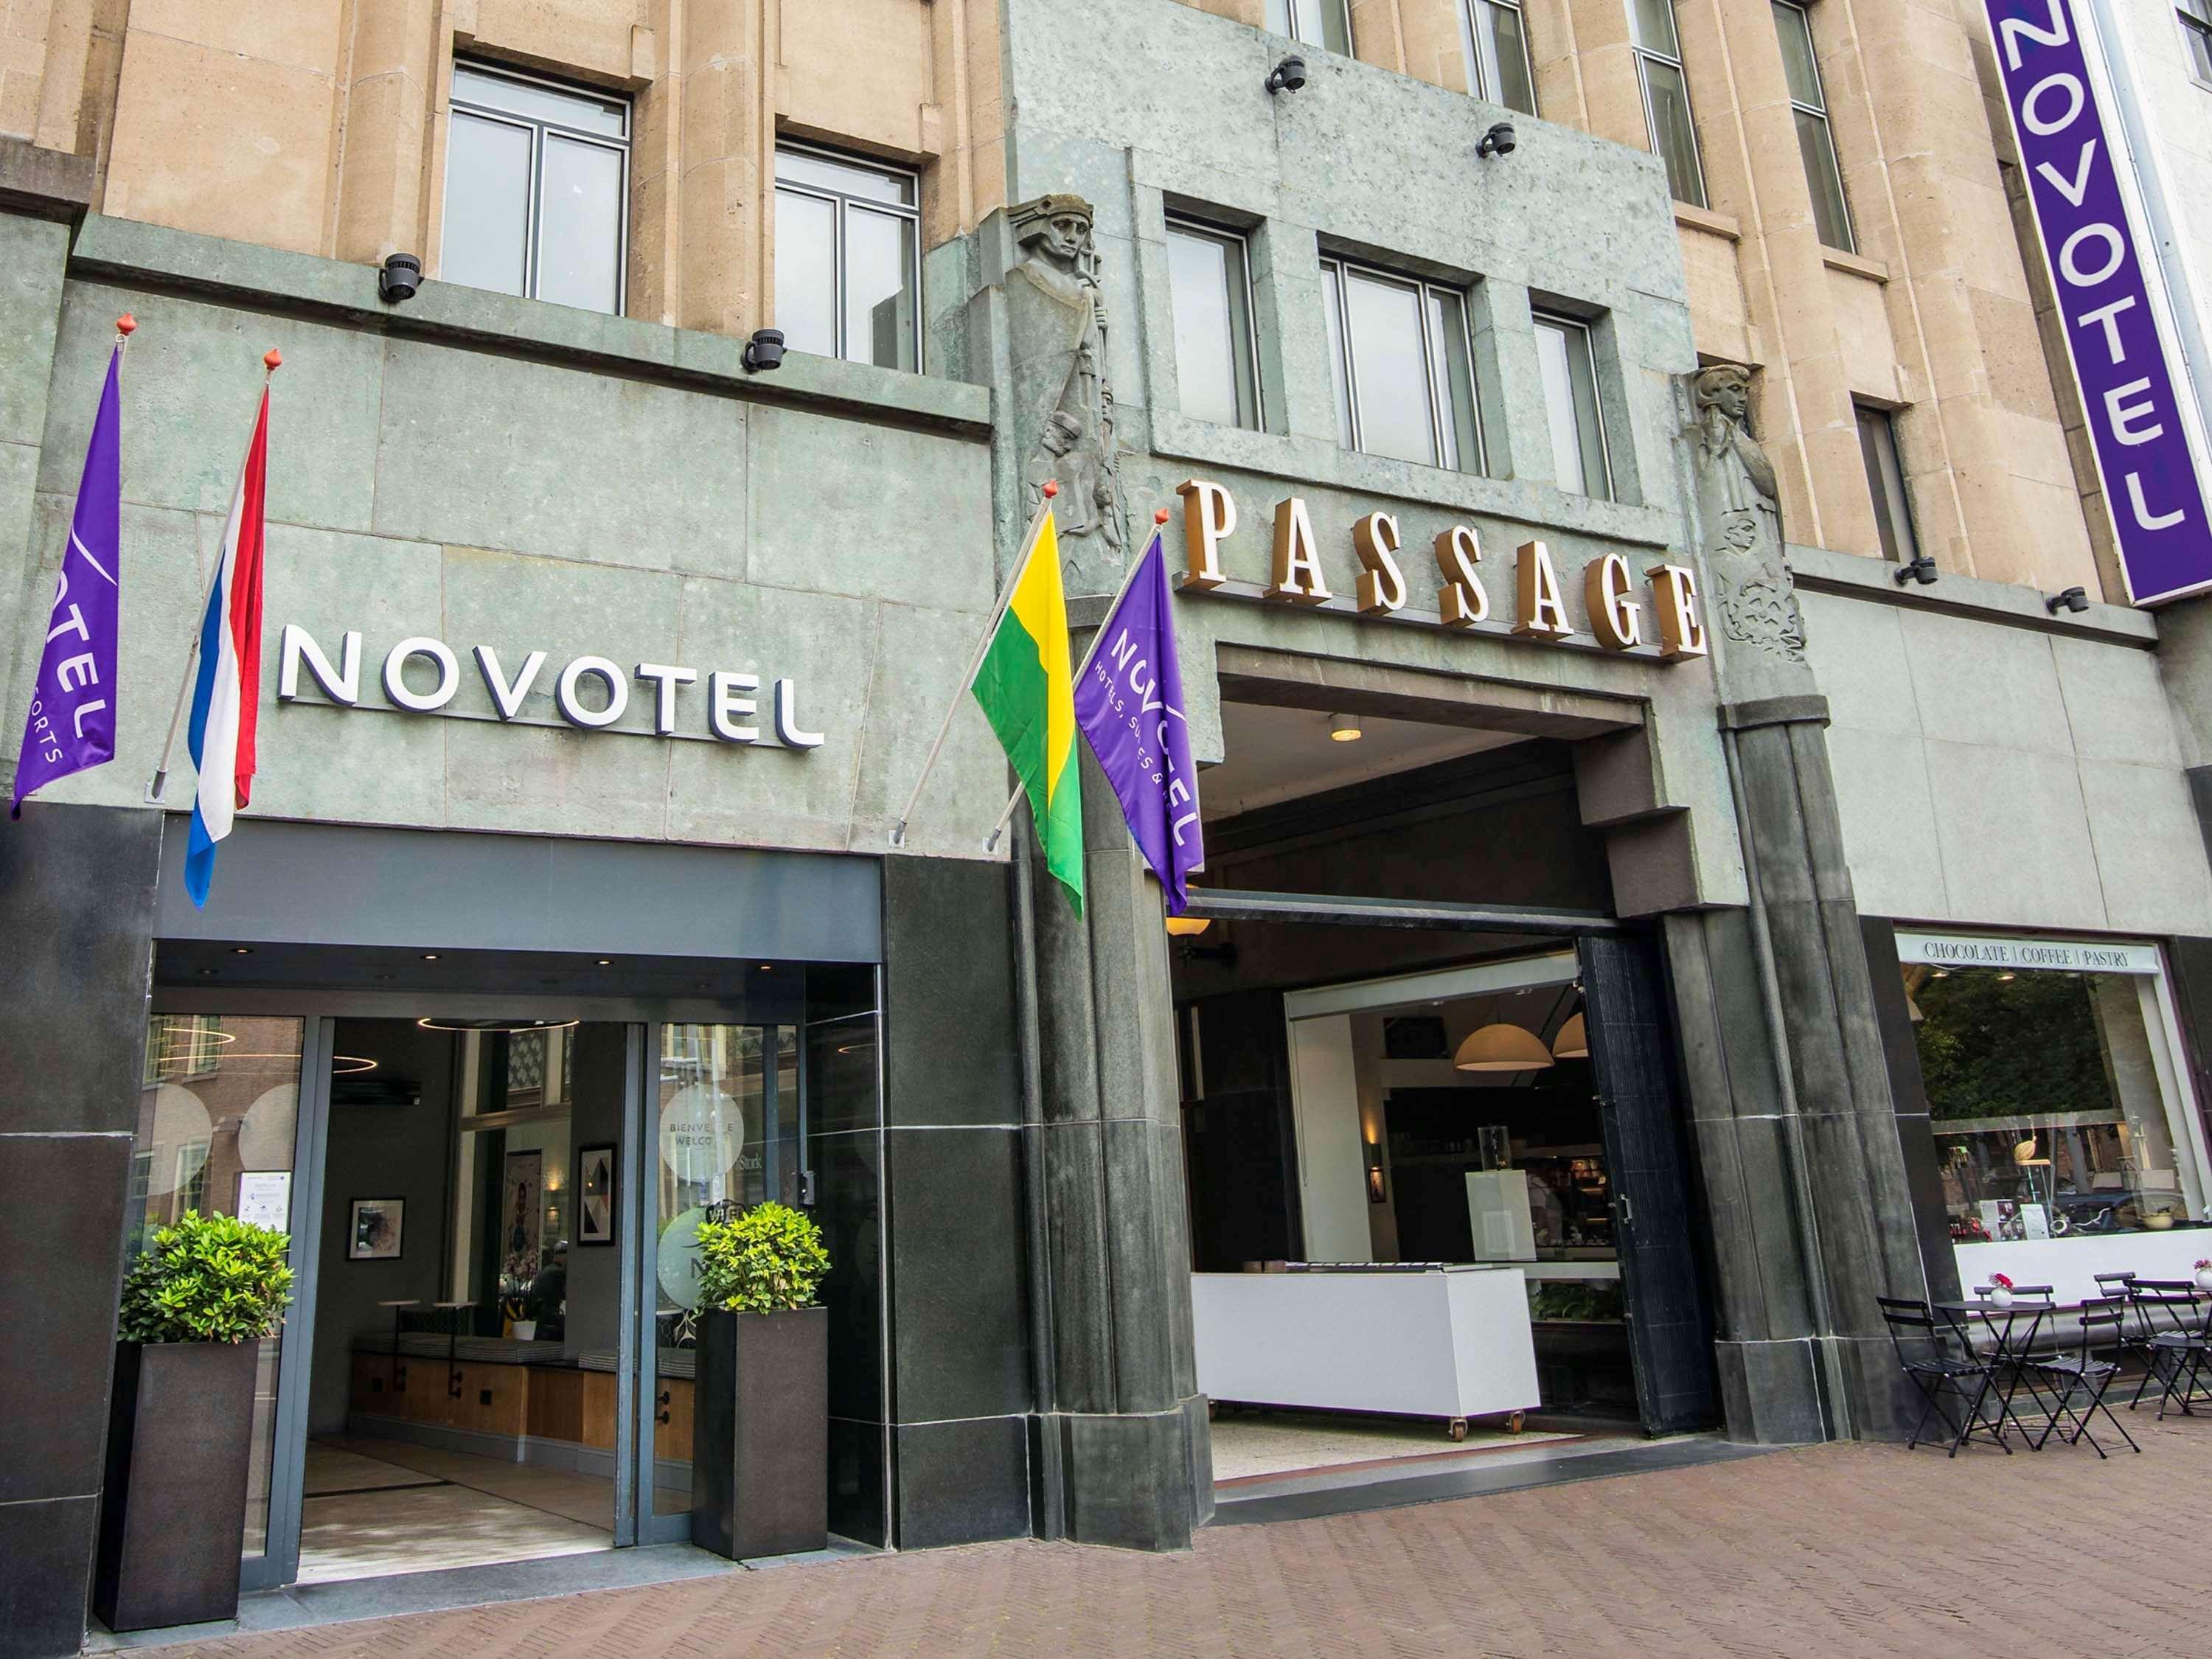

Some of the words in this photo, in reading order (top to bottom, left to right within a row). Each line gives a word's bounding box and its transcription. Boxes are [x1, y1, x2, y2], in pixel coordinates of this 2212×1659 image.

[1998, 0, 2186, 532] NOVOTEL
[1176, 479, 1708, 662] PASSAGE
[31, 686, 63, 764] ORTS
[277, 624, 825, 748] NOVOTEL
[1094, 661, 1124, 719] HOTELS,
[1110, 627, 1197, 847] NOVOEL
[1924, 942, 2008, 962] CHOCOLATE
[2022, 947, 2073, 965] COFFEE
[2083, 950, 2131, 967] PASTRY
[669, 1123, 734, 1133] BIENVEE
[675, 1136, 728, 1146] WELCO
